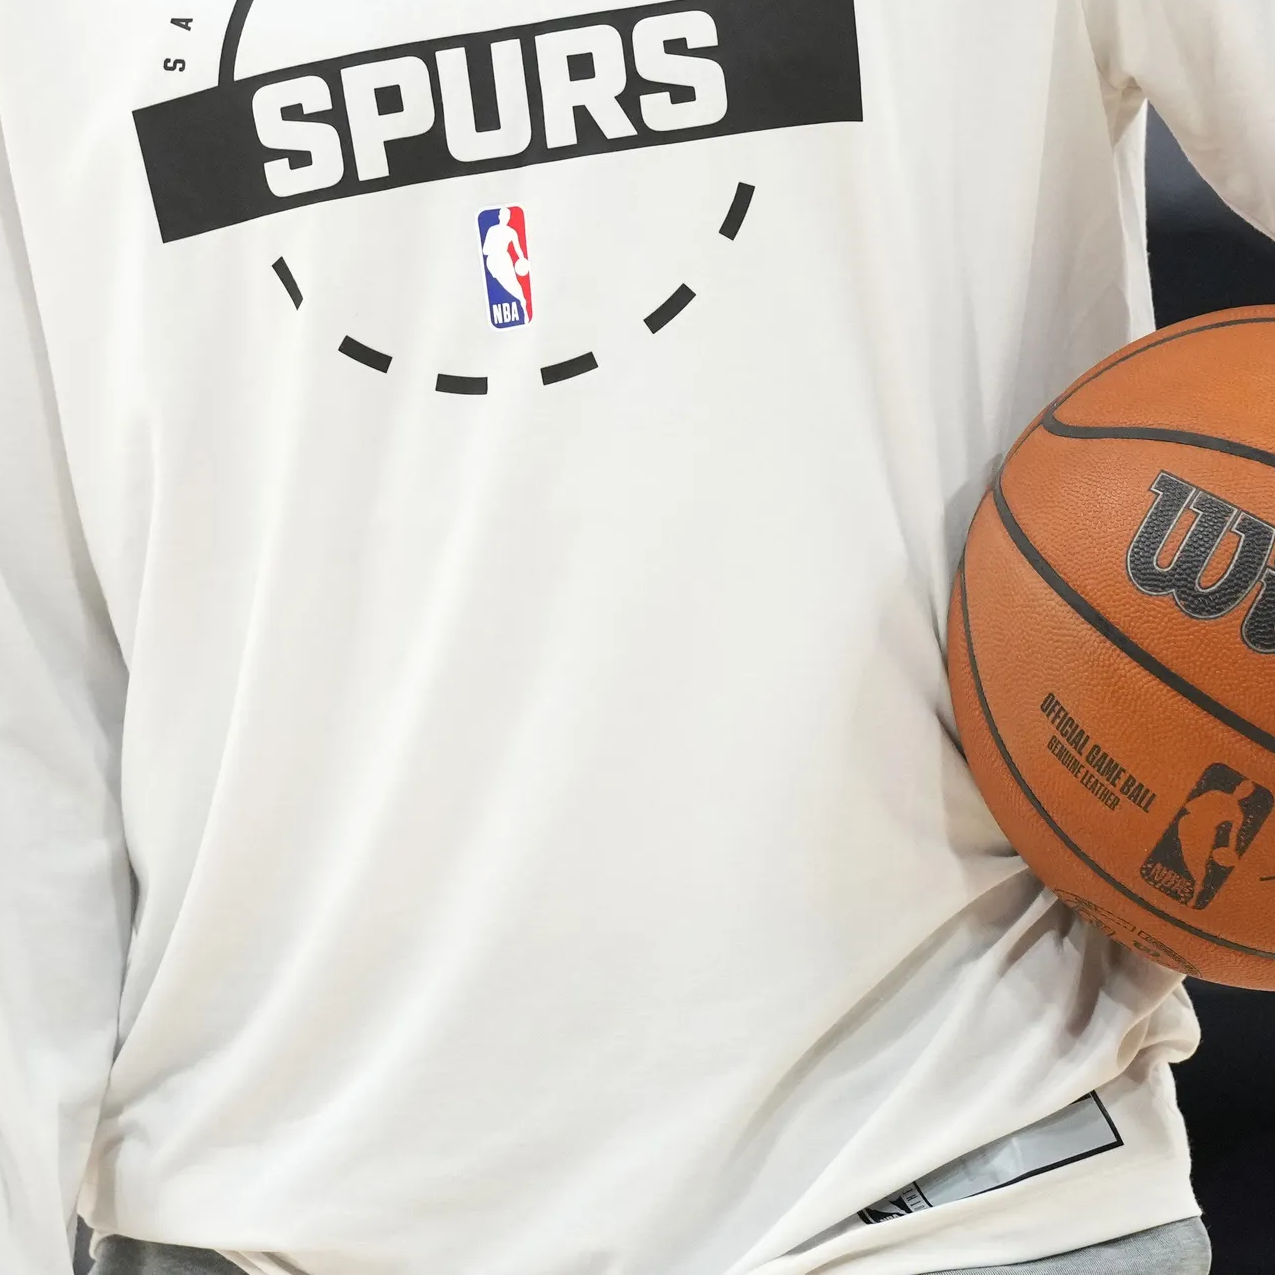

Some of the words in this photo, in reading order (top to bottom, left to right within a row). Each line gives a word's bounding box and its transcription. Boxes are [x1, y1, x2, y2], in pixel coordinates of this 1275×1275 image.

[251, 9, 728, 199] SPURS
[492, 301, 520, 325] NBA
[1040, 692, 1090, 756] OFFICIAL
[1085, 743, 1127, 788] GAME
[1119, 774, 1157, 814] BALL
[1046, 734, 1086, 779] GENUINE
[1079, 769, 1121, 811] LEATHER
